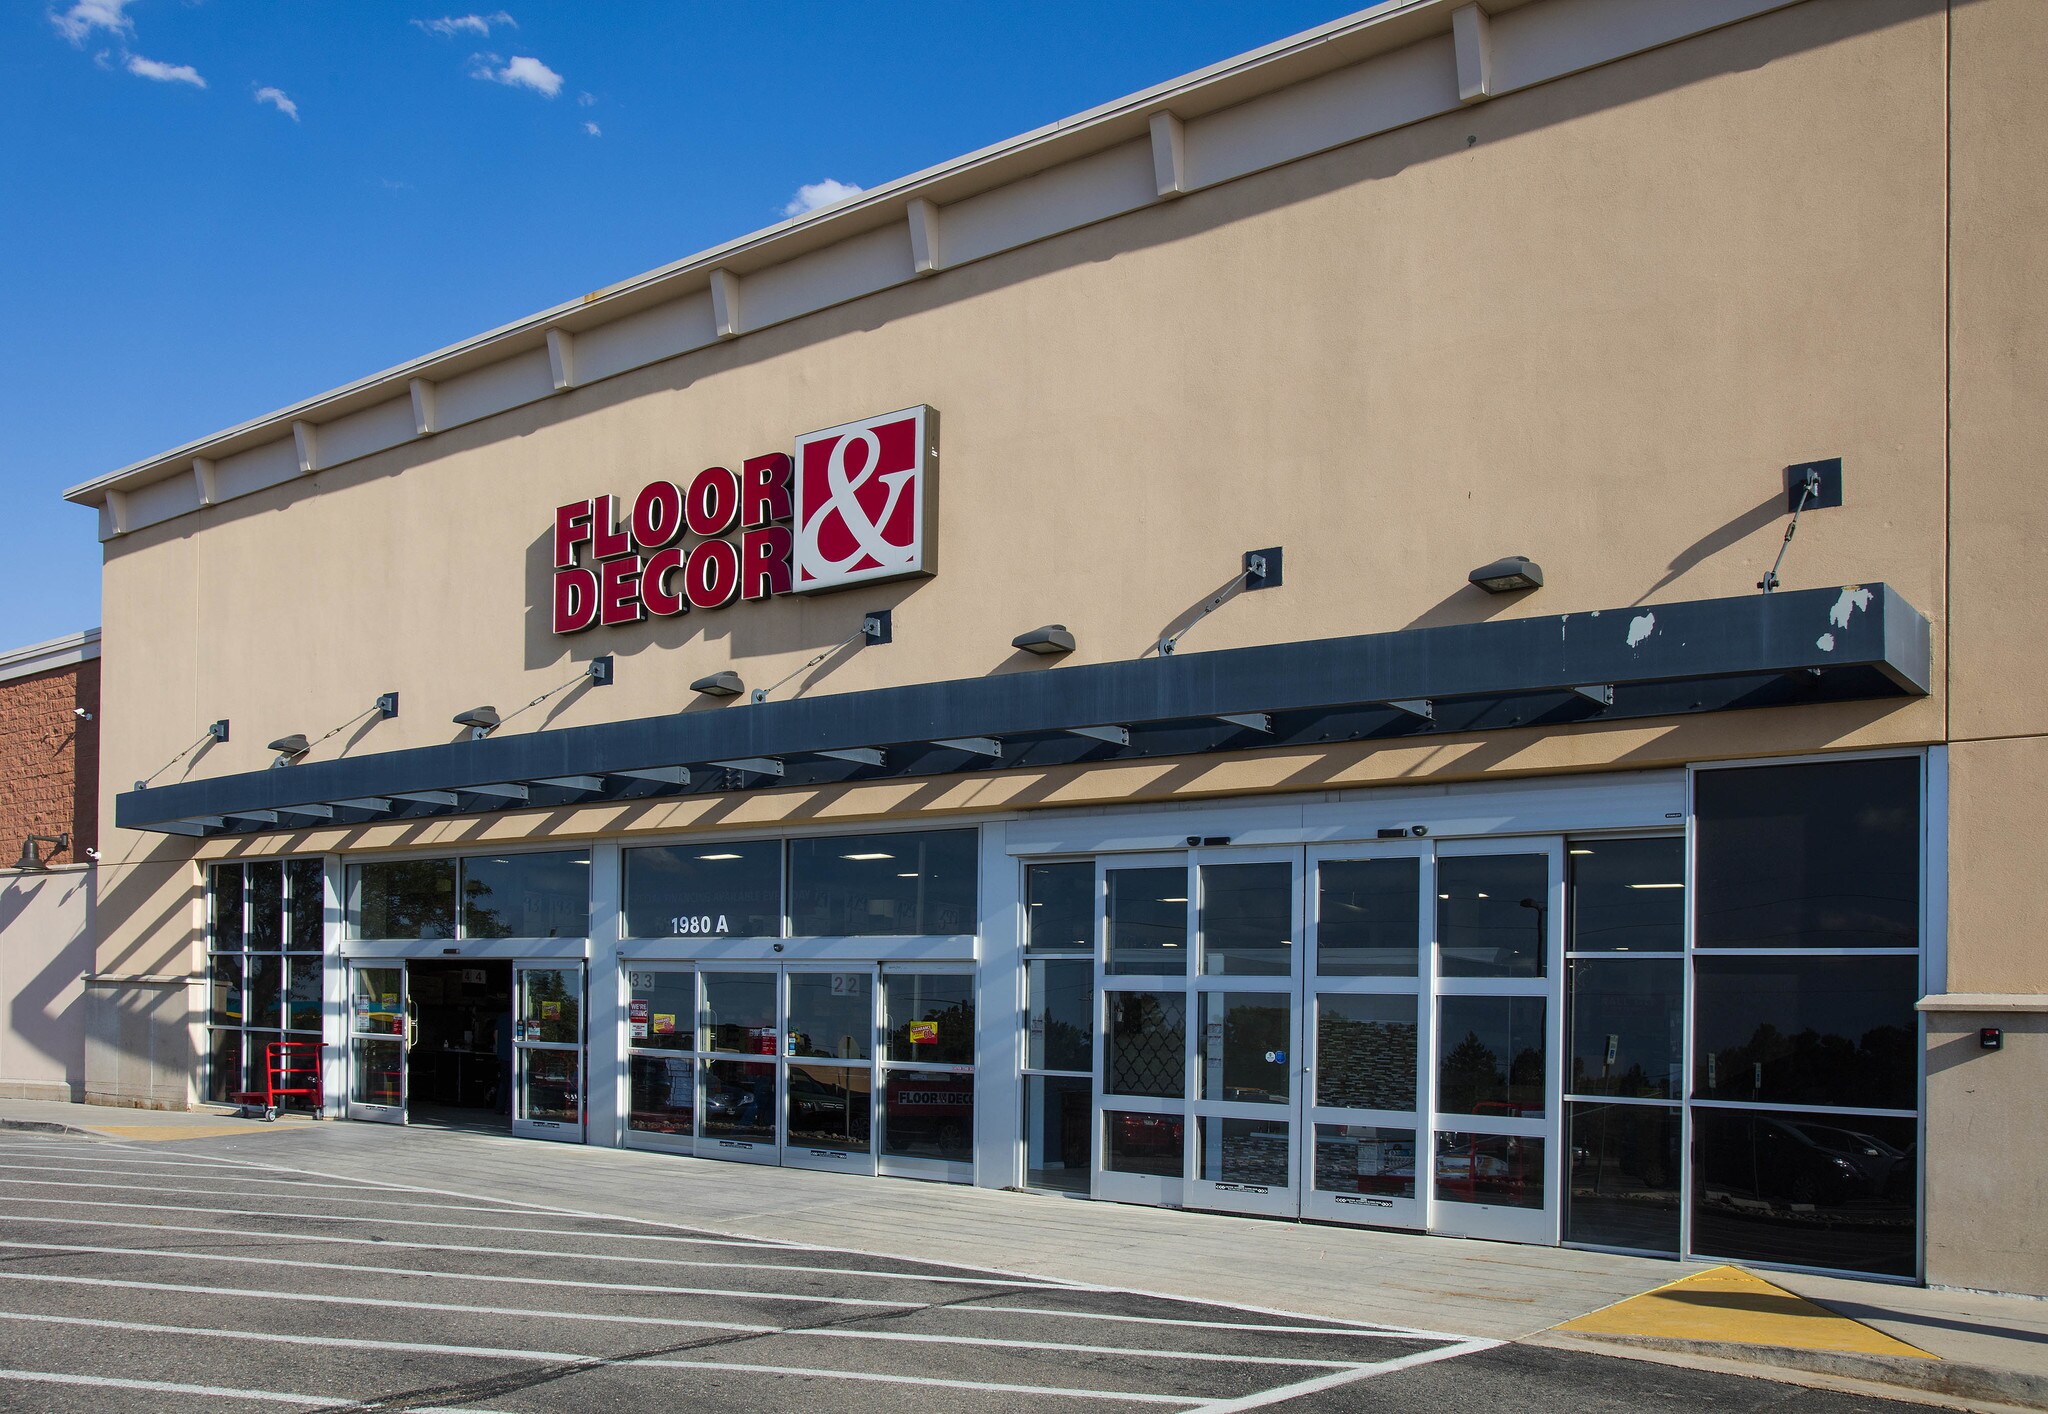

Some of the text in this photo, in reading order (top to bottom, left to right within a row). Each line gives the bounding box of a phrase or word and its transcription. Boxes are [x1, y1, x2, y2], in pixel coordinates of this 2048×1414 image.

[554, 451, 794, 569] FLOOR
[553, 526, 794, 635] DECOR
[671, 914, 729, 934] 1980 A
[899, 1092, 939, 1104] FLOOR
[948, 1093, 974, 1104] DECO
